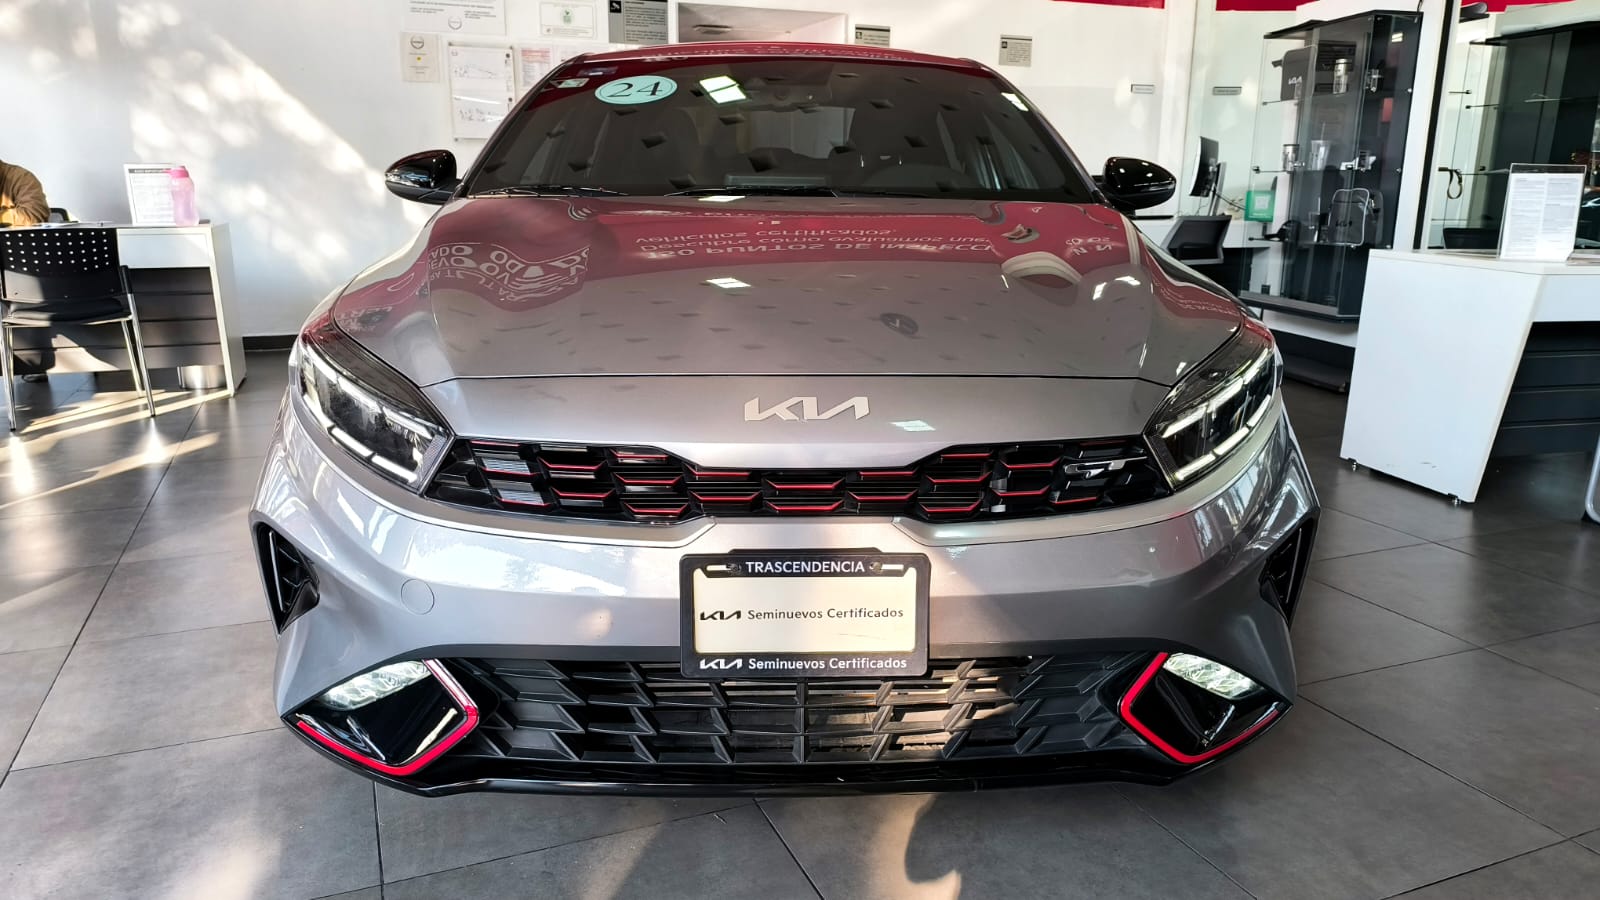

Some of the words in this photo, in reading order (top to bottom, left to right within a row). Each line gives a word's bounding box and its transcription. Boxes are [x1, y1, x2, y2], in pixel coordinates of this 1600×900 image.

[607, 81, 663, 98] 24
[744, 396, 870, 421] KIA
[745, 561, 865, 574] TRASCENDENCIA
[699, 610, 742, 621] KIA
[747, 609, 823, 620] Seminuevos
[827, 607, 904, 619] Certificados
[699, 658, 743, 670] KIA
[748, 658, 826, 670] Seminuevos
[829, 657, 908, 669] Certificados
